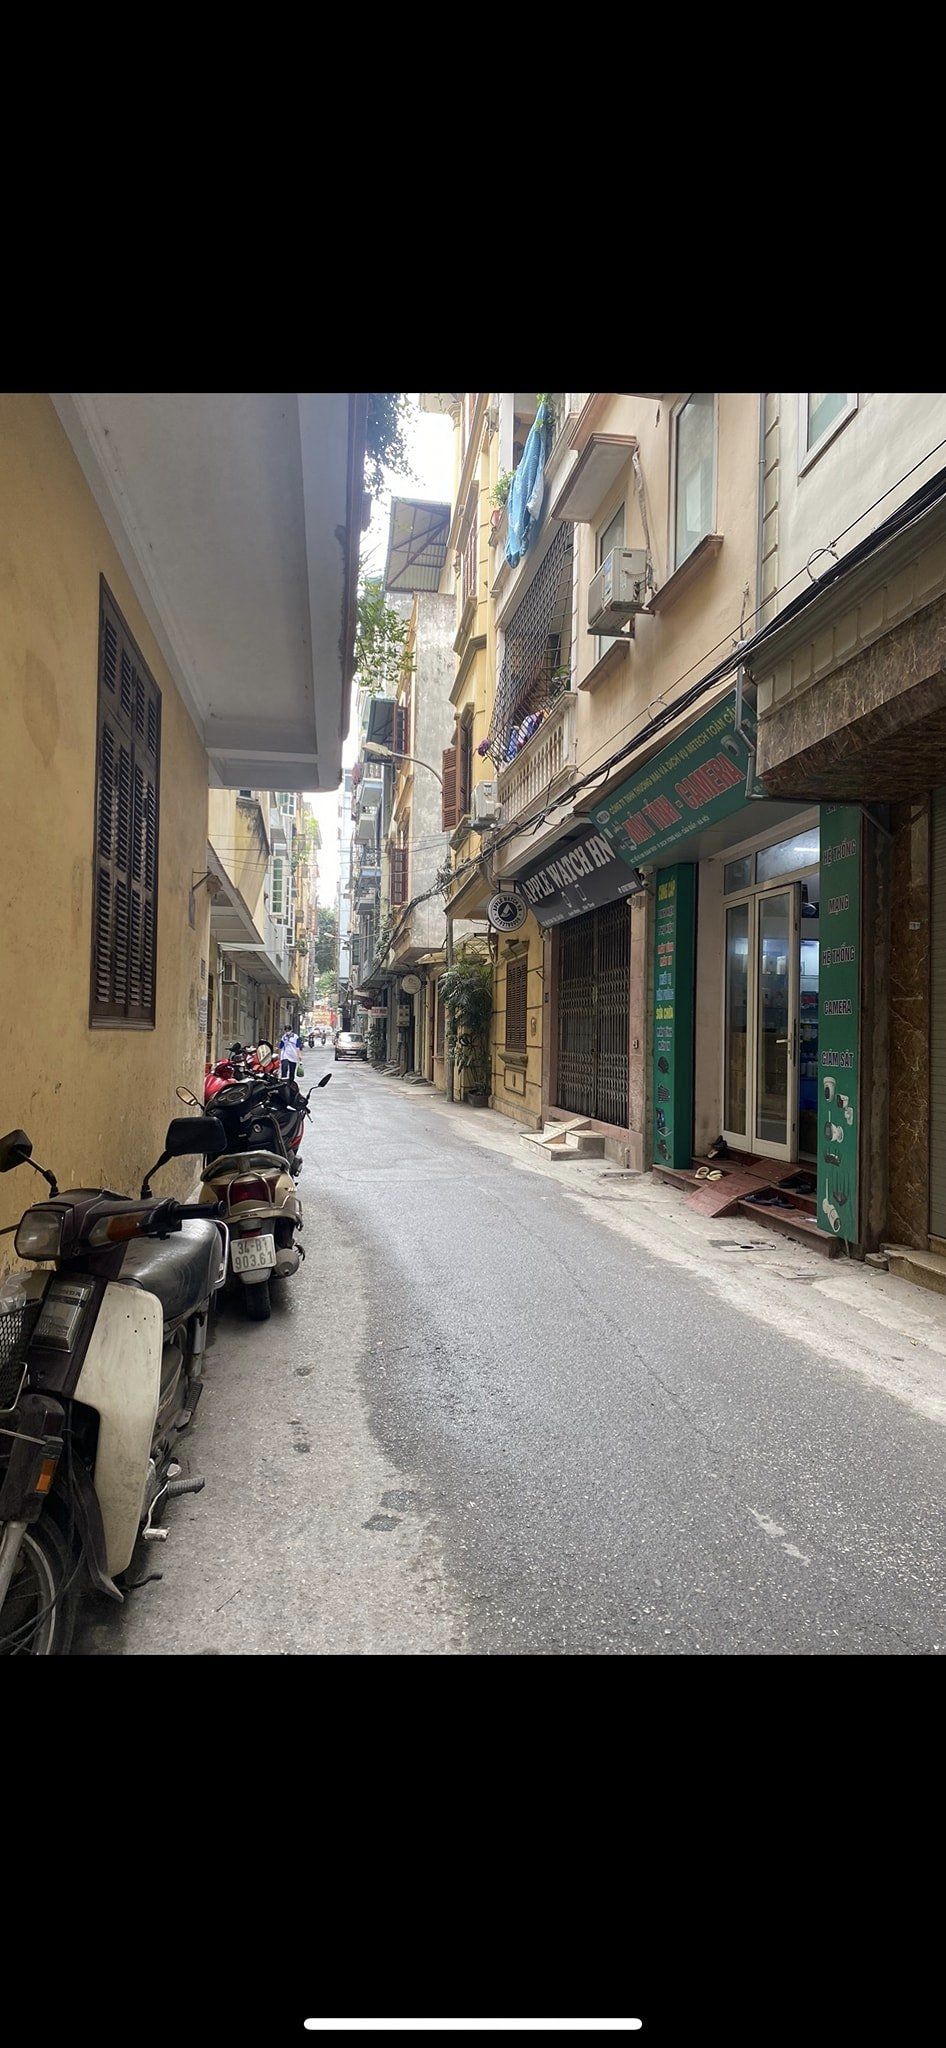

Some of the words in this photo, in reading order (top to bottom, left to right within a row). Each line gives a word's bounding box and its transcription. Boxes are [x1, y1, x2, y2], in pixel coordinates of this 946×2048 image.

[675, 752, 746, 809] CAMERA
[823, 846, 832, 867] HỆ
[833, 838, 856, 861] THỐNG
[521, 868, 554, 904] APPLE
[546, 845, 594, 888] WATCH
[585, 833, 616, 868] HN
[828, 894, 849, 915] MẠNG
[823, 947, 831, 968] HỆ
[833, 942, 855, 963] THỐNG
[824, 999, 852, 1015] CAMERA
[822, 1048, 838, 1067] GIÁM
[840, 1049, 853, 1068] SÁT
[235, 1251, 273, 1269] 903.61
